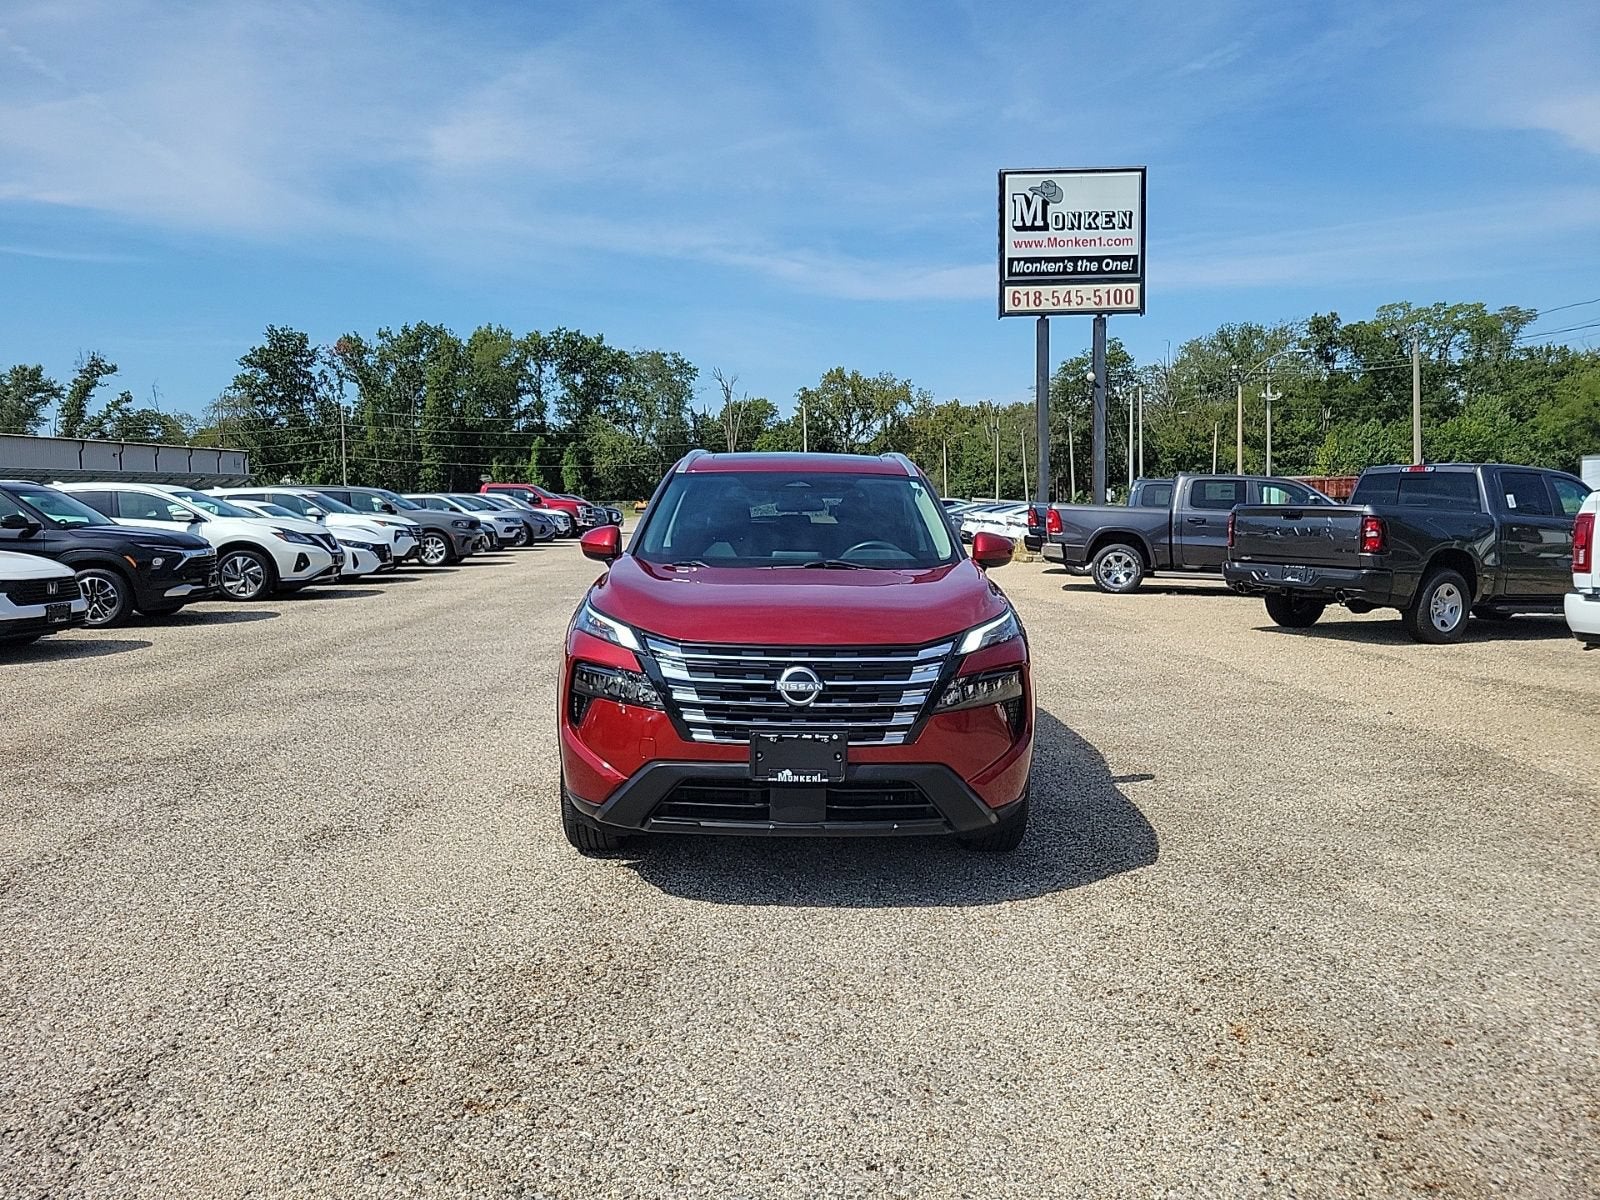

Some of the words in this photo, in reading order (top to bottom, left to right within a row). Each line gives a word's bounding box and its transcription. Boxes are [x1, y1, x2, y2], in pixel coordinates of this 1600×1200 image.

[1012, 193, 1133, 231] MONKEN
[1013, 236, 1133, 248] www.Monken1.com
[1012, 260, 1073, 273] Monken's
[1077, 259, 1098, 271] the
[1102, 258, 1133, 271] One!
[1012, 288, 1134, 307] 618-545-5100
[777, 682, 822, 691] NISSAN
